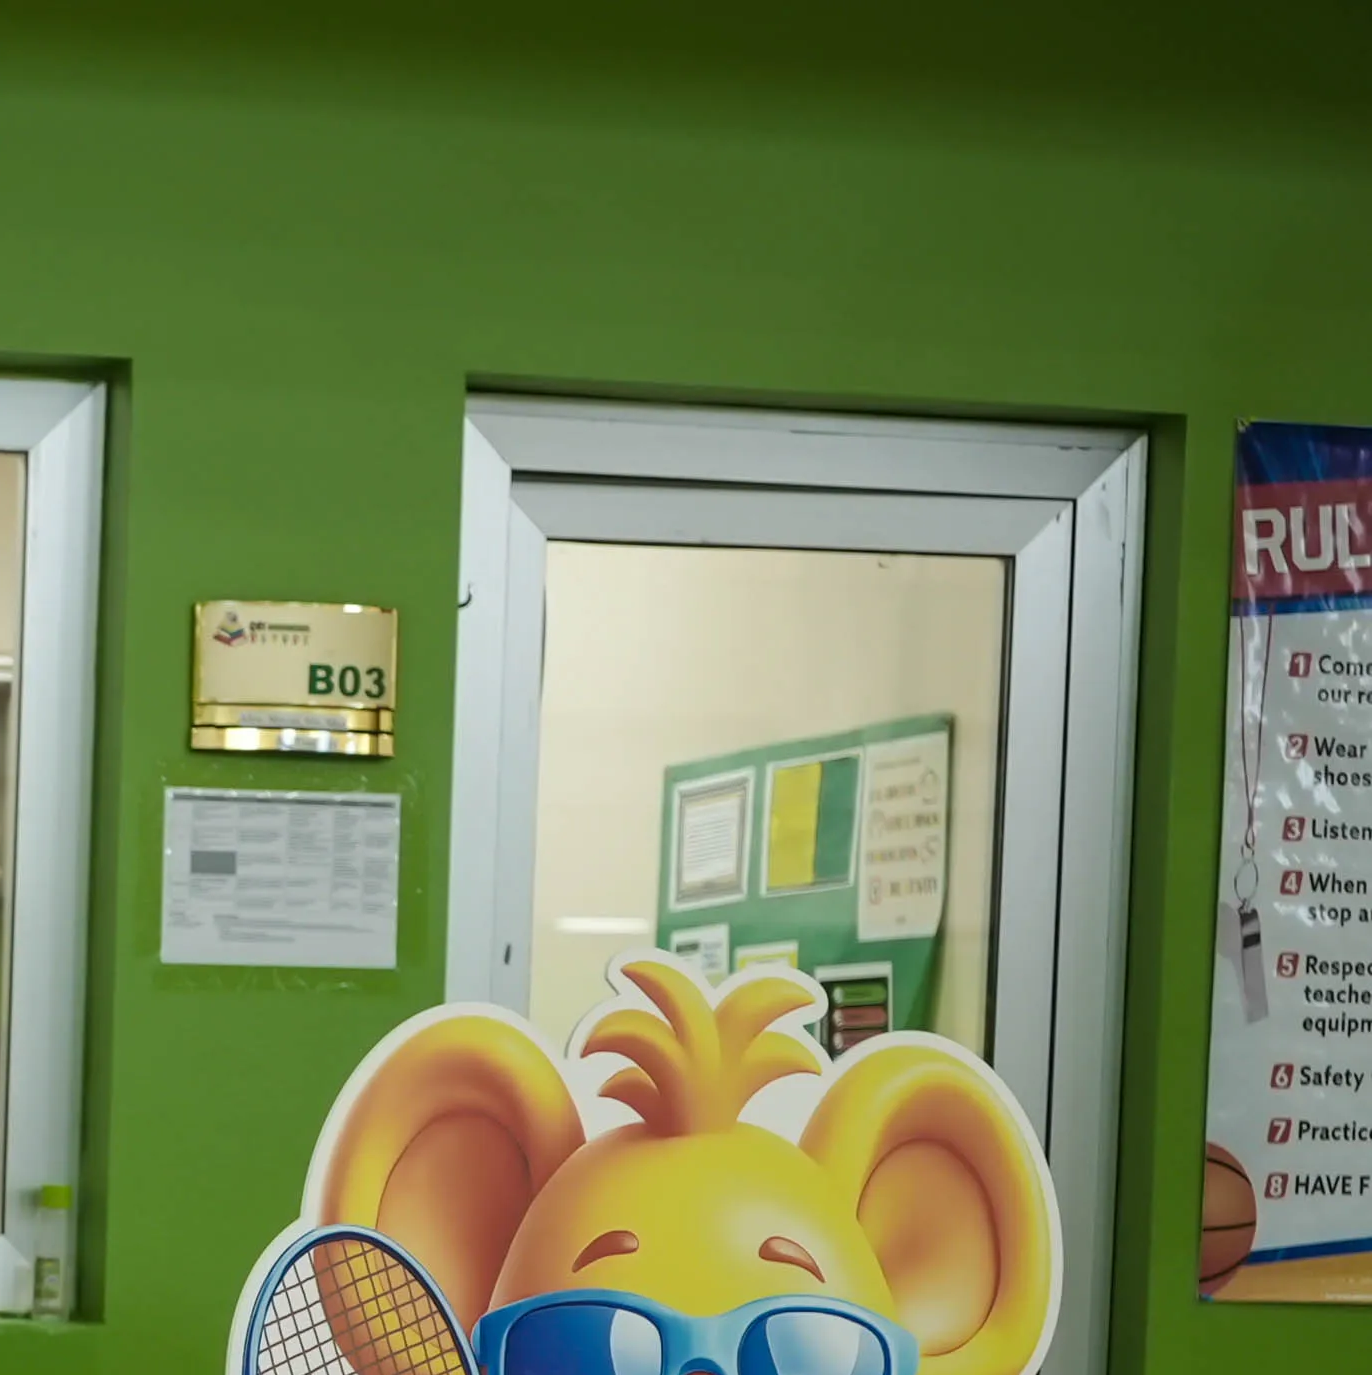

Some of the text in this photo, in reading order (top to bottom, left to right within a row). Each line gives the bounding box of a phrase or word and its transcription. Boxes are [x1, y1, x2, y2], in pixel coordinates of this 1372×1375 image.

[308, 663, 386, 698] B03
[1318, 689, 1351, 703] our
[1314, 737, 1367, 758] Wear
[1313, 766, 1372, 786] shoes
[1311, 819, 1372, 841] Listen
[1309, 872, 1367, 894] When
[1307, 904, 1372, 927] stop a
[1299, 1064, 1365, 1093] Safety
[1295, 1175, 1352, 1196] HAVE
